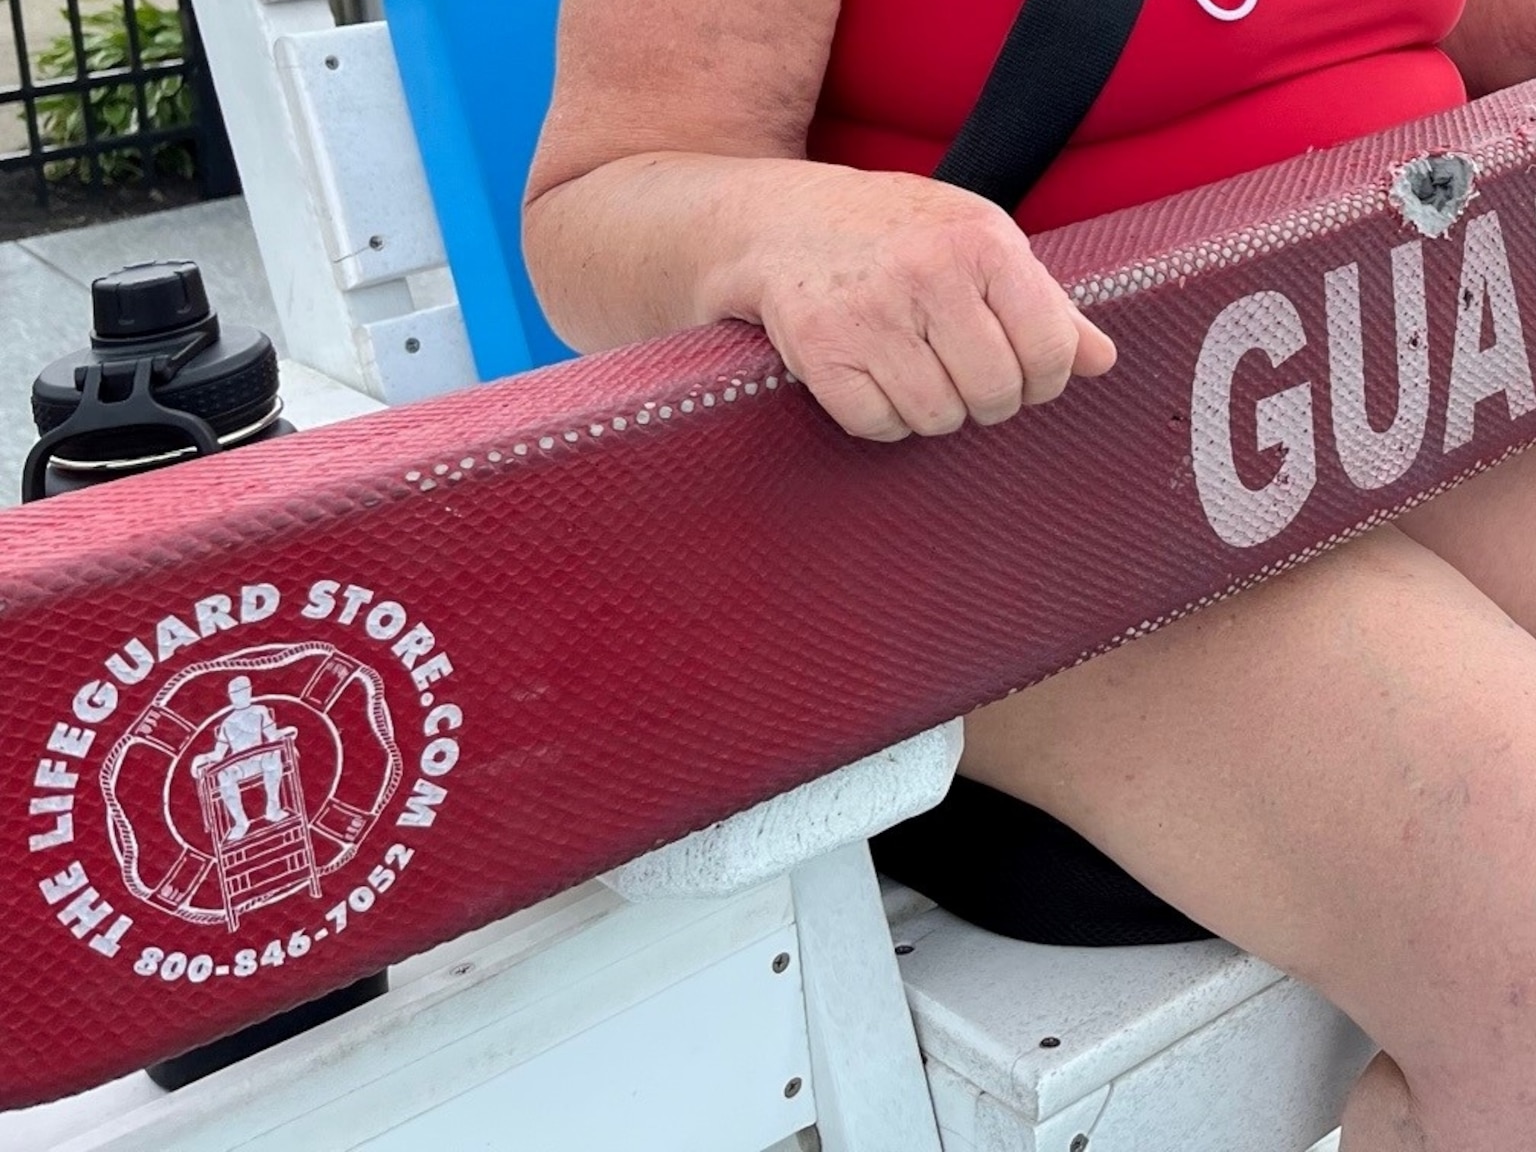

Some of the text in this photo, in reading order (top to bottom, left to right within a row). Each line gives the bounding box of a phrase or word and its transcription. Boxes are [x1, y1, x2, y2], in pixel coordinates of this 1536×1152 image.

[28, 579, 464, 958] THE LIFEGUARD STORE.COM
[133, 843, 416, 983] 800-846-7052
